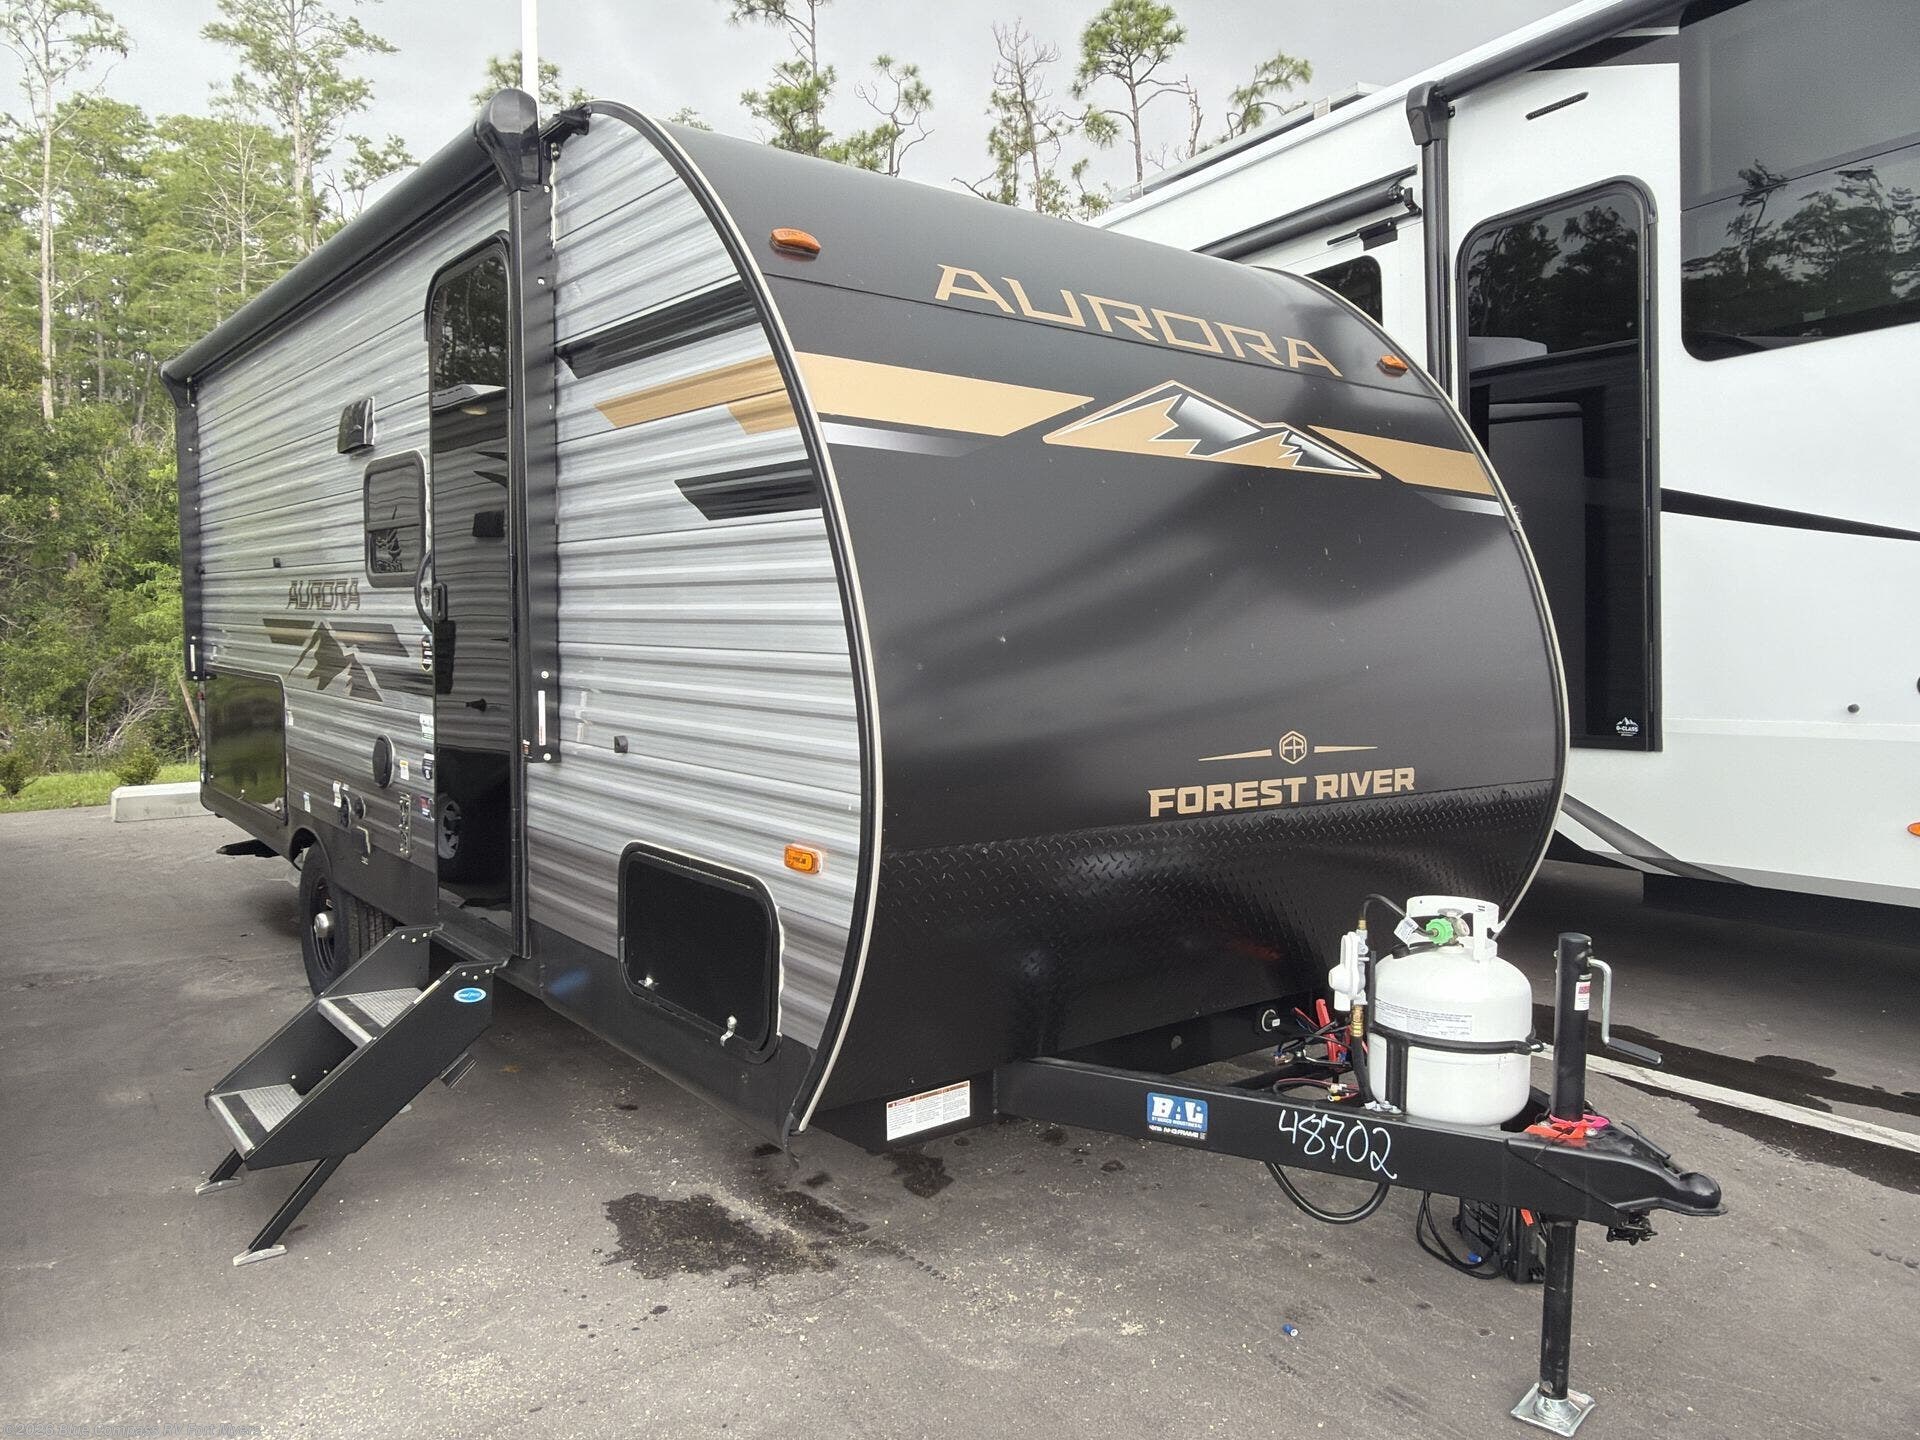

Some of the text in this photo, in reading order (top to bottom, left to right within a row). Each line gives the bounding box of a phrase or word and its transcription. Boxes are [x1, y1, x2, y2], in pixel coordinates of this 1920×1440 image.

[934, 263, 1343, 377] AURORA
[286, 578, 360, 611] AURORA
[1148, 767, 1415, 817] FOREST RIVER
[1151, 1096, 1204, 1124] BAL
[1278, 1109, 1398, 1179] 48702
